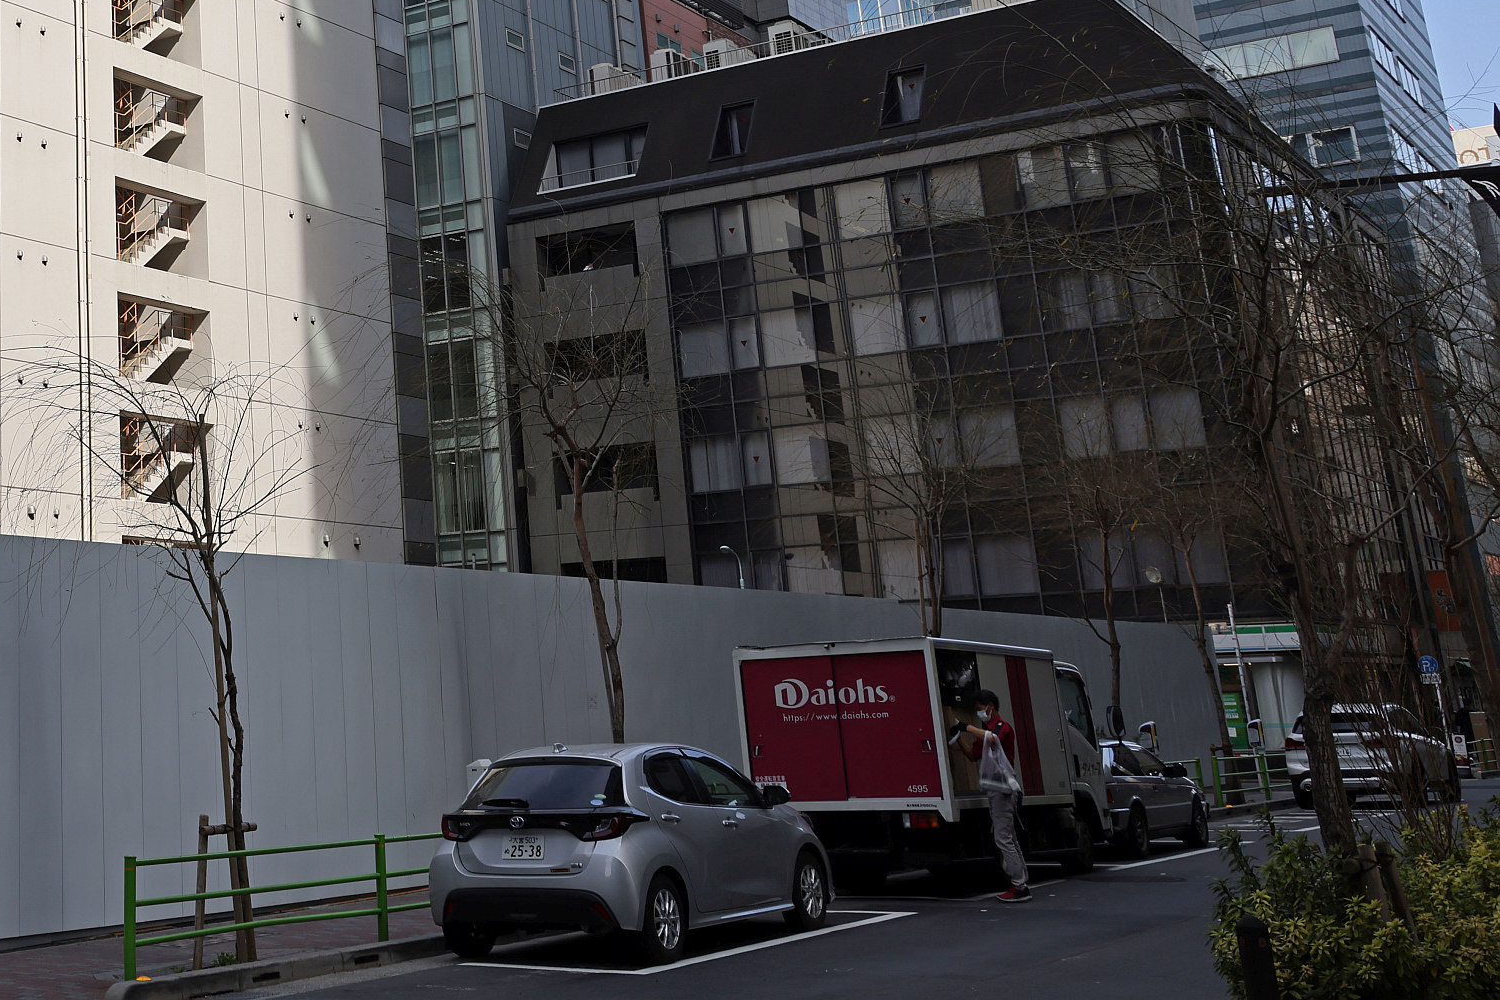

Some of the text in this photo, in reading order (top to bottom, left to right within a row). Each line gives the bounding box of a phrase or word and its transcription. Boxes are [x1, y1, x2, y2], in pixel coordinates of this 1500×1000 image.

[774, 678, 889, 709] Daiohs
[783, 710, 889, 724] https://www.daiohs.com
[907, 784, 929, 793] 4595
